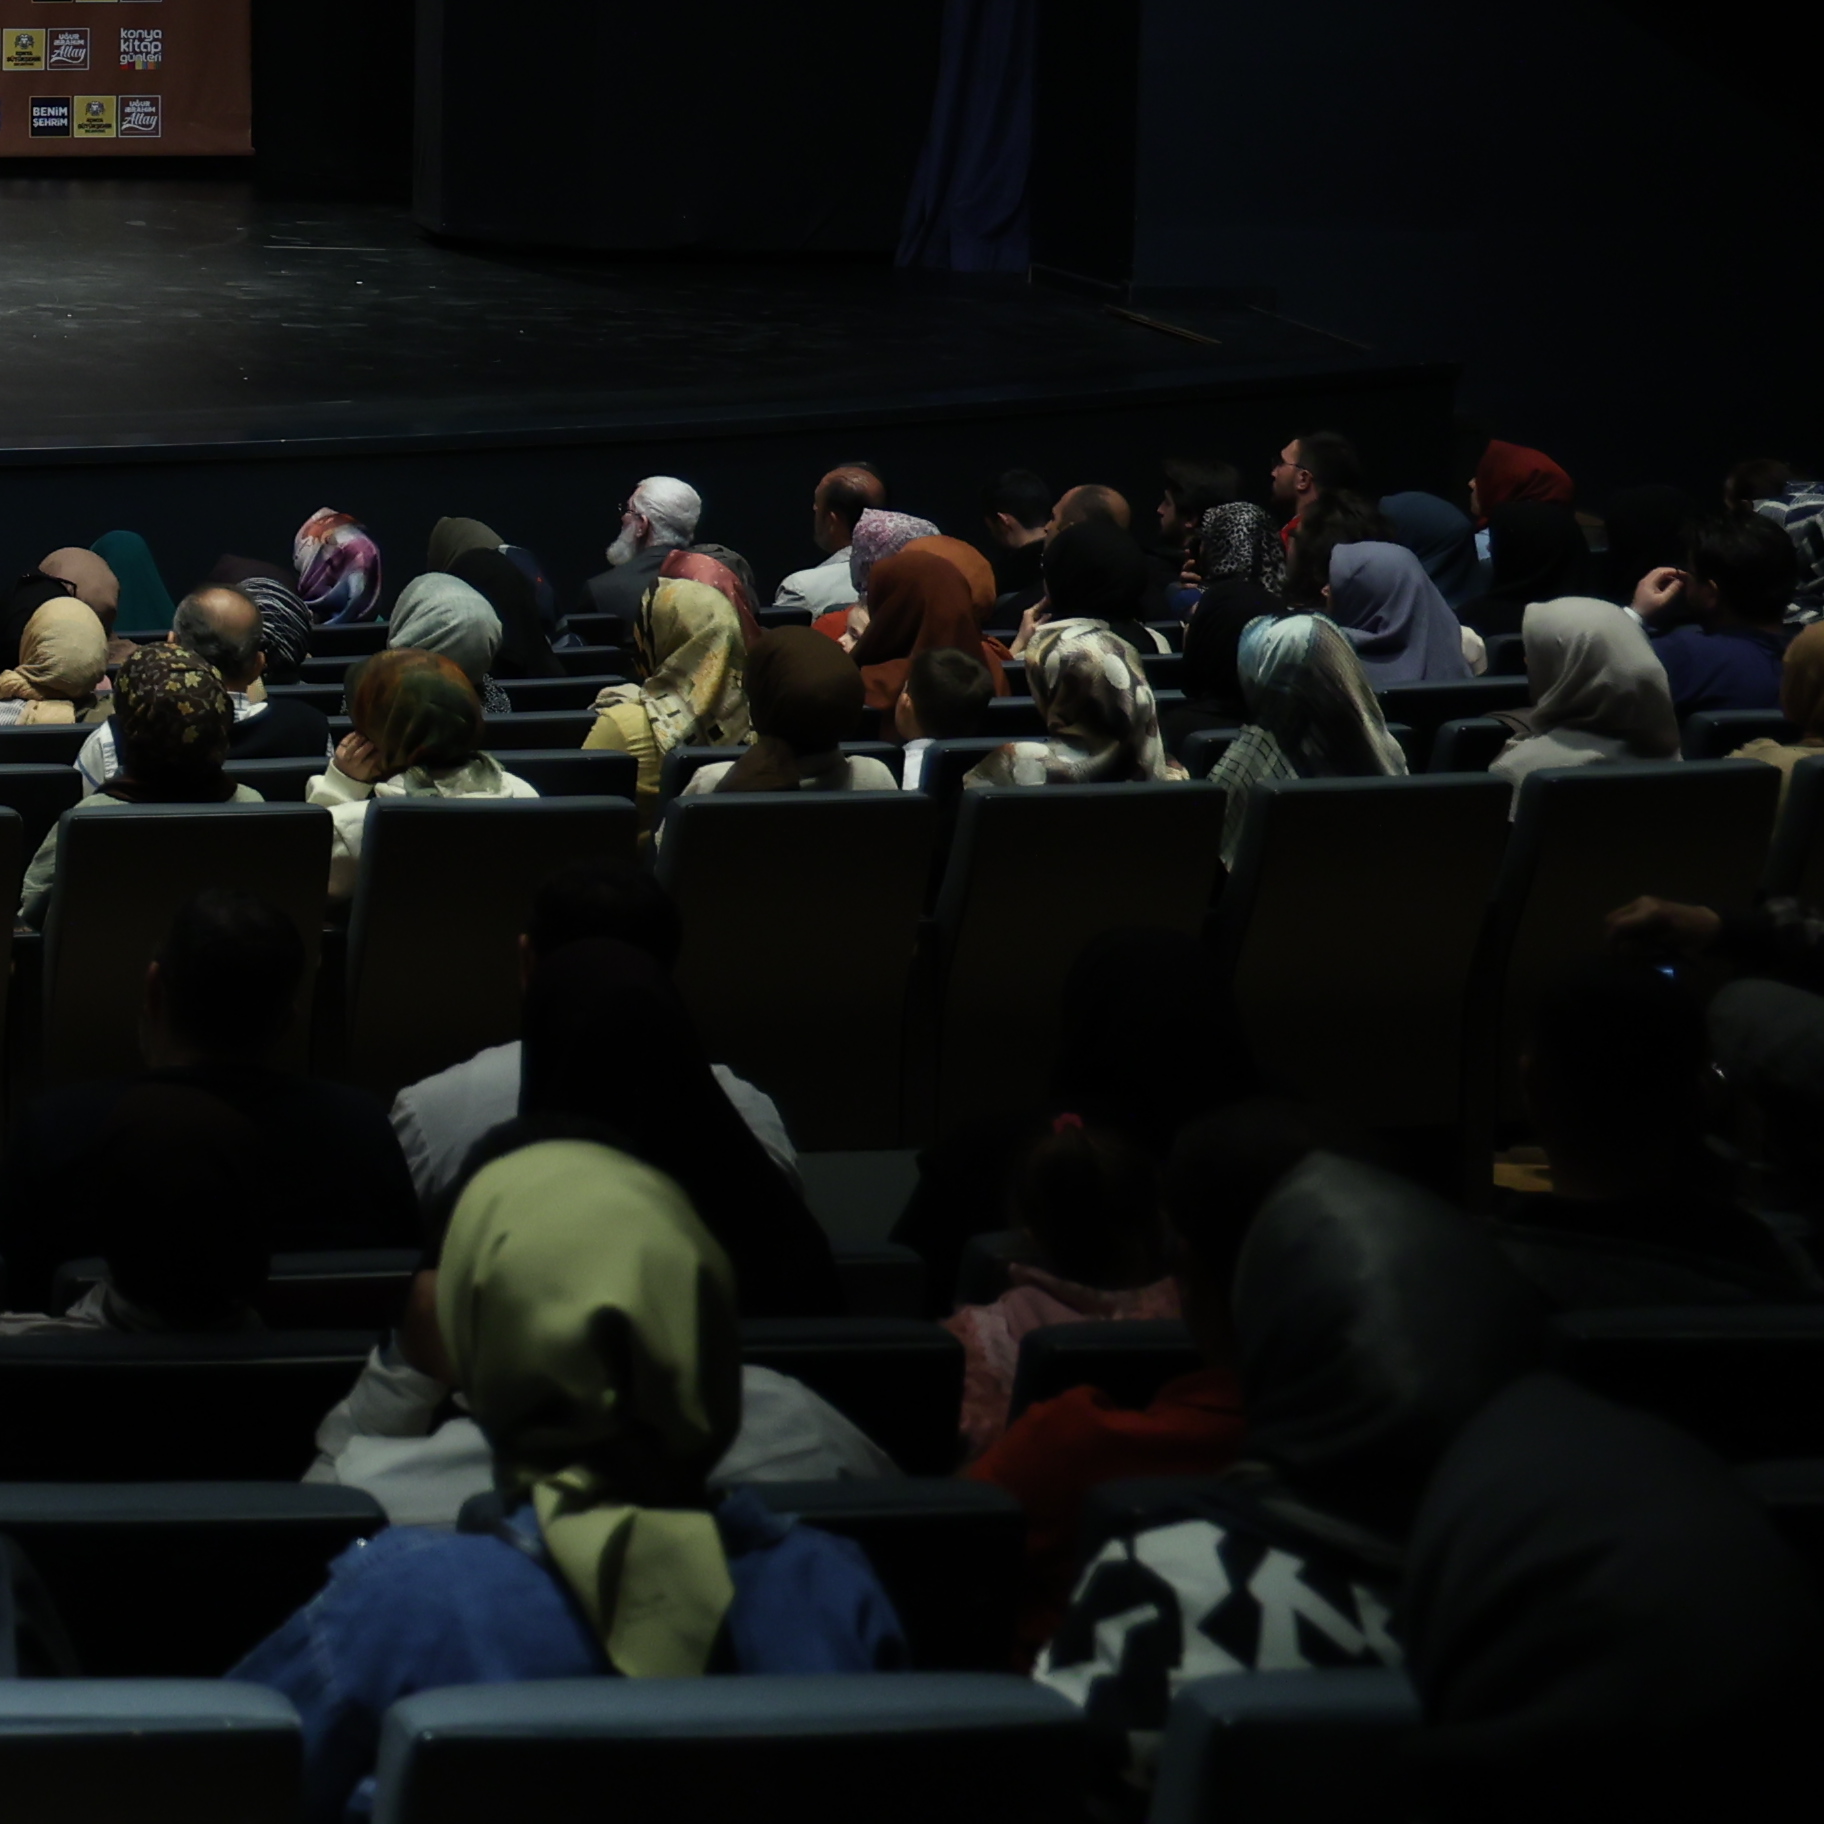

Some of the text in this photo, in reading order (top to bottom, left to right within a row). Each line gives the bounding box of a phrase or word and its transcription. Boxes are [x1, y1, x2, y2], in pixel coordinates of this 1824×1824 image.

[119, 27, 163, 41] konya
[119, 40, 163, 54] kitap
[119, 53, 163, 65] günleri
